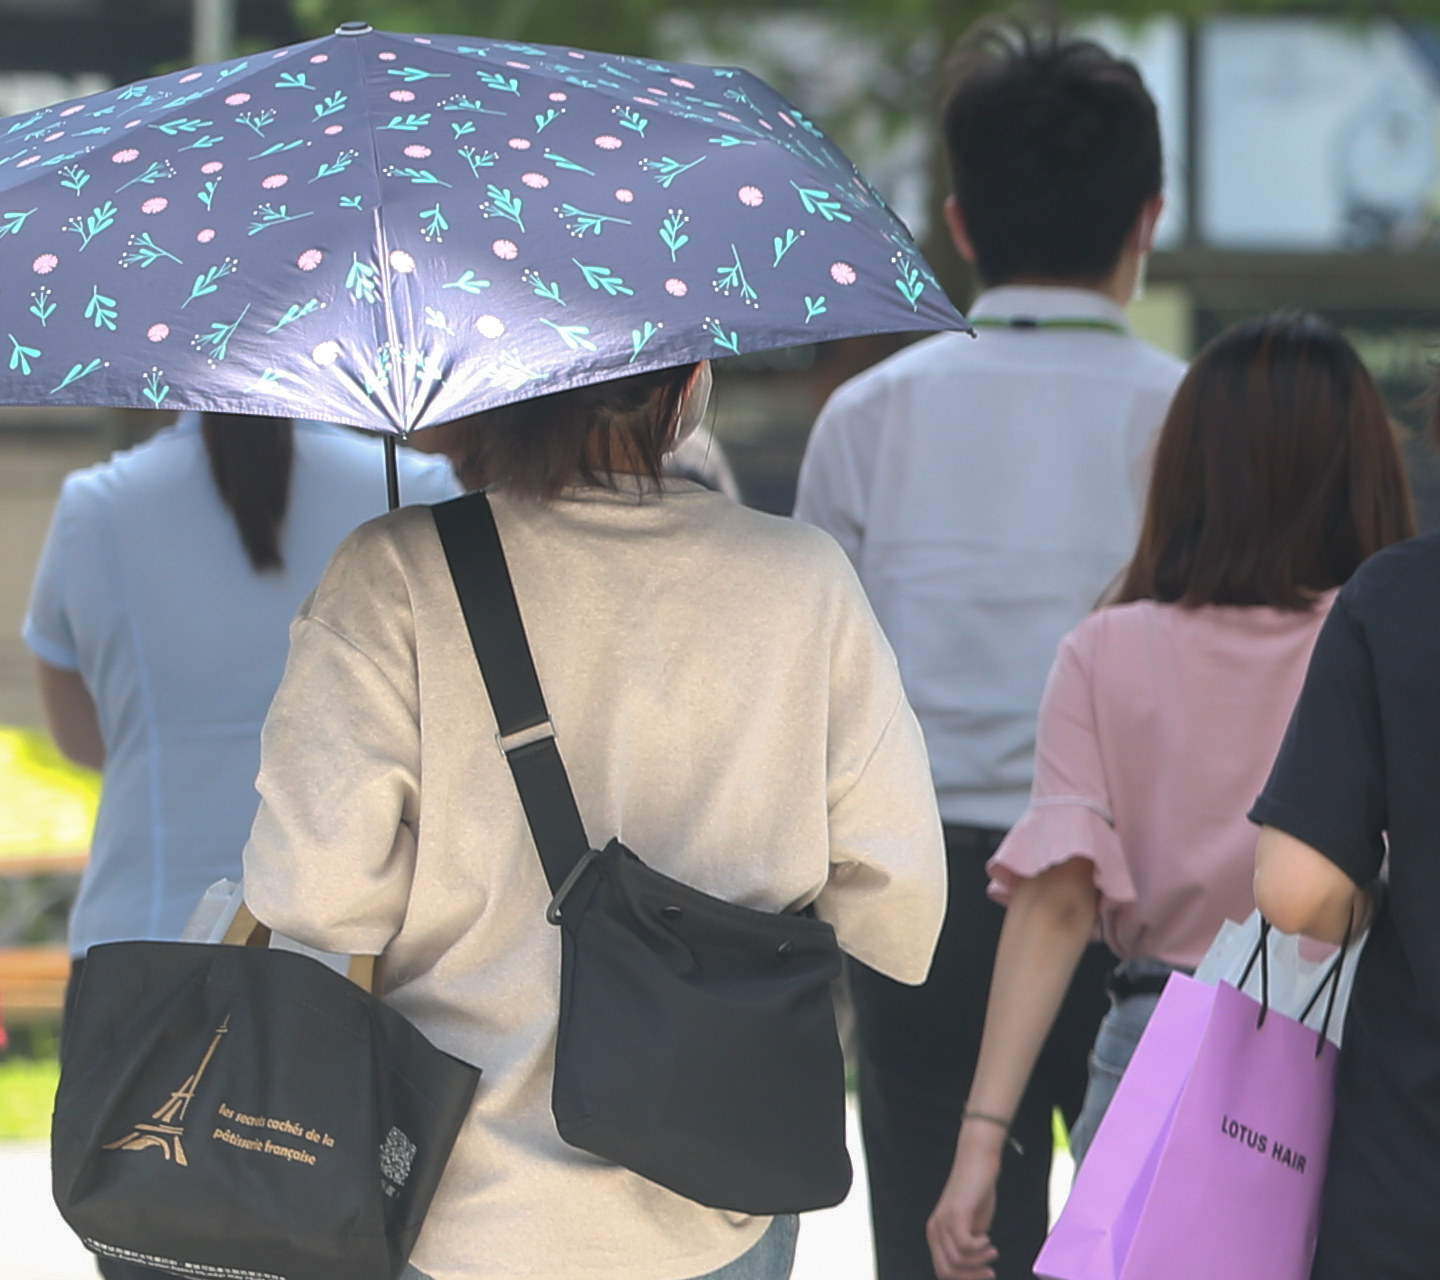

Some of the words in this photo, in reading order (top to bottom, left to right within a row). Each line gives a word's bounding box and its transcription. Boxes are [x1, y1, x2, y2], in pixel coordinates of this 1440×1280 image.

[305, 1129, 321, 1143] de
[322, 1133, 335, 1147] la
[1221, 1115, 1268, 1154] LOTUS
[1271, 1141, 1307, 1174] HAIR
[264, 1139, 317, 1165] française
